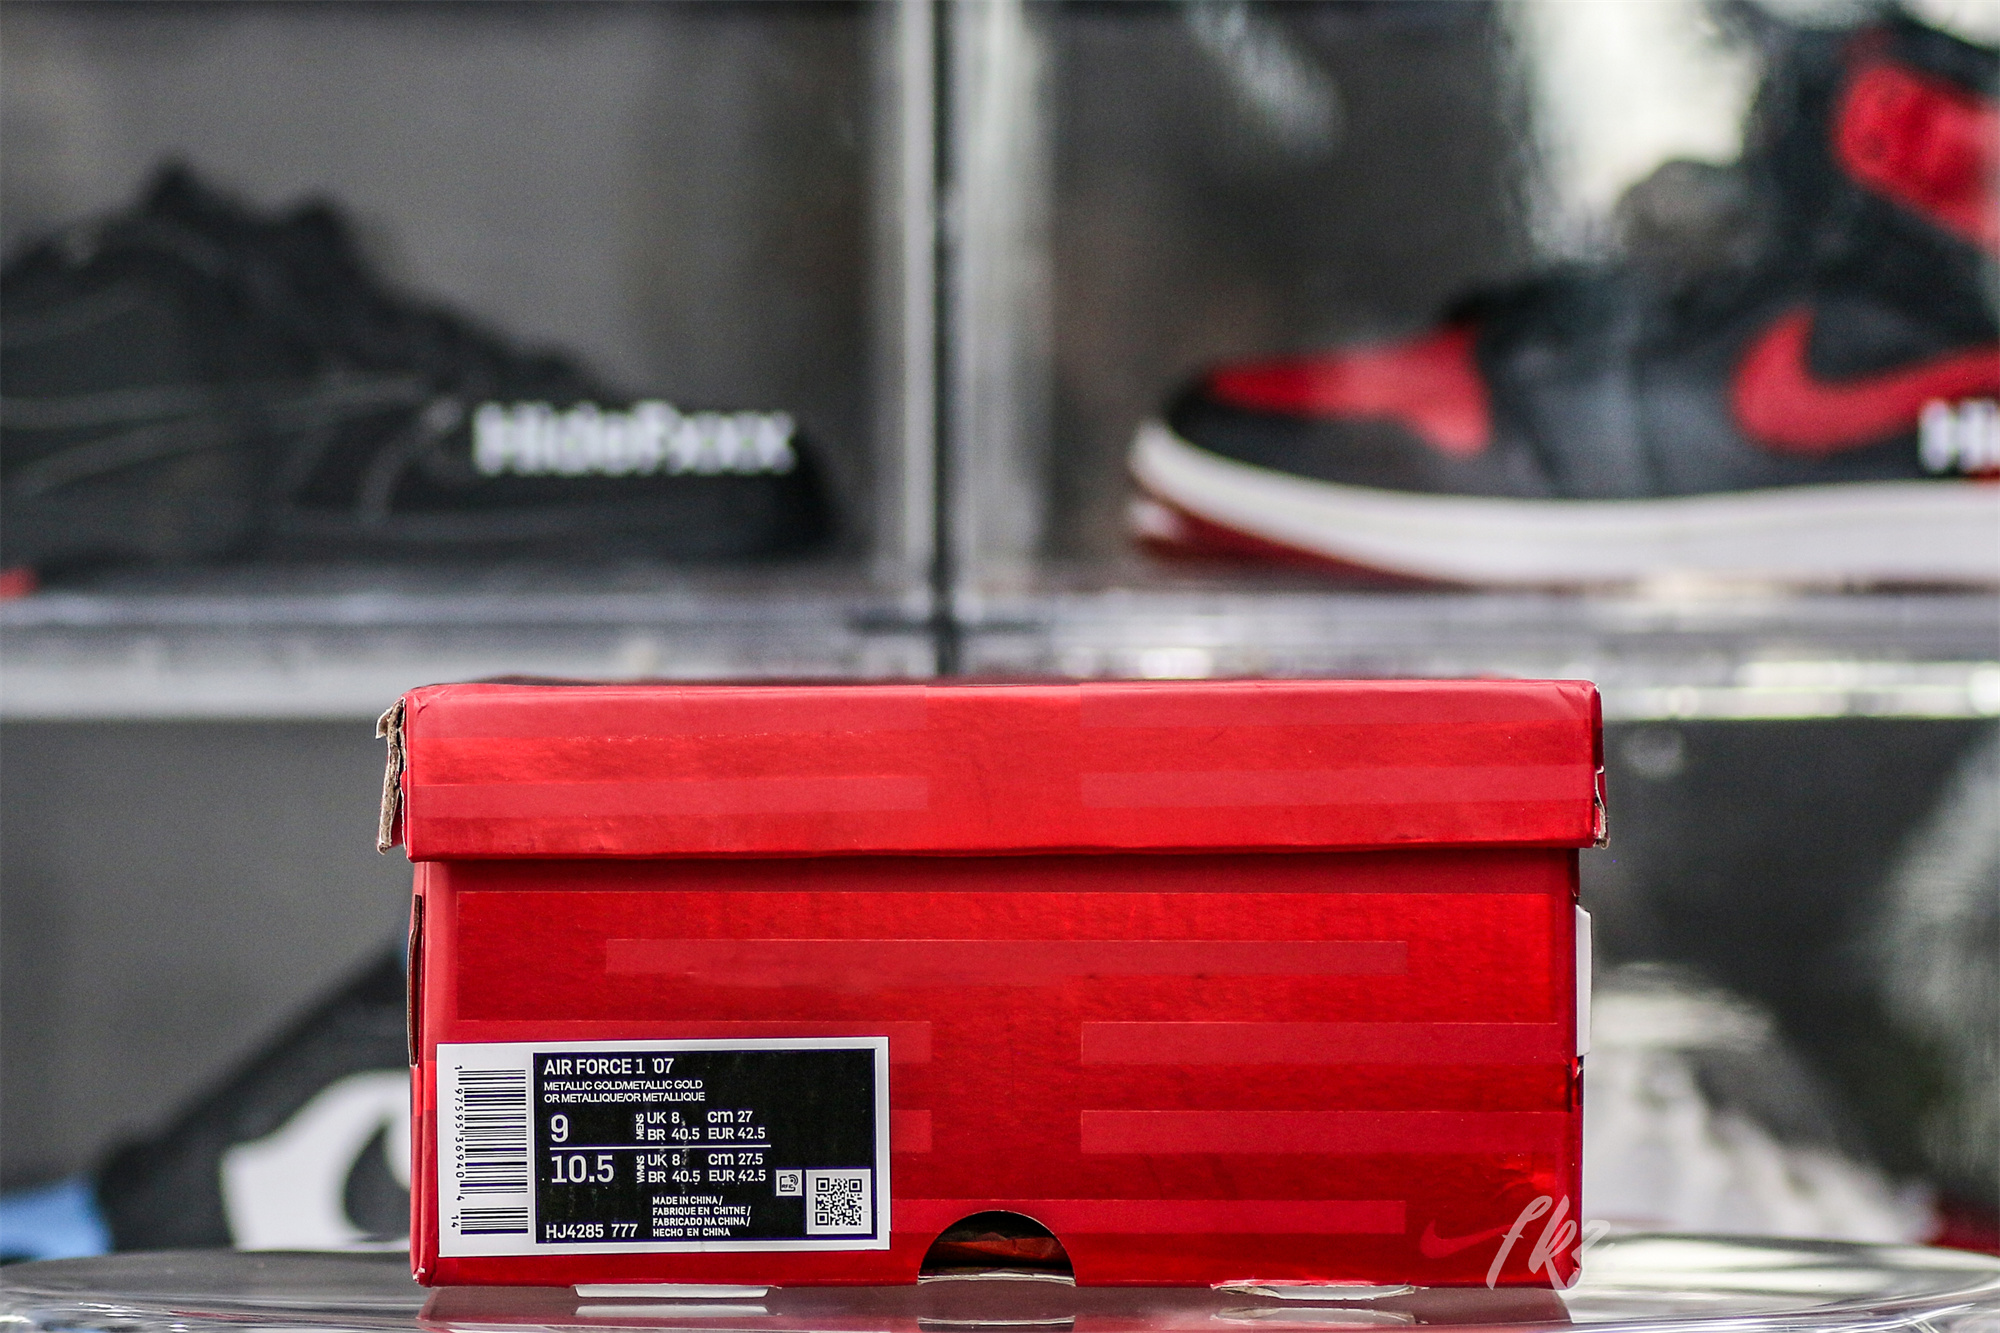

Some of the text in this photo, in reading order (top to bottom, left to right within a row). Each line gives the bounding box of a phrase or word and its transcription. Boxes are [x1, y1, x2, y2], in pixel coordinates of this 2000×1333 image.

[543, 1057, 675, 1076] AIR FORCE 1 '07
[543, 1079, 704, 1091] METALLIC GOLD/METALLIC GOLD
[544, 1092, 706, 1104] OR METALLIQUE/OR METALLIQUE
[646, 1110, 753, 1124] UK 8 cm 27
[550, 1114, 569, 1143] 9
[635, 1113, 645, 1140] MENS
[647, 1127, 766, 1141] BR 40.5 EUR 42.5
[647, 1153, 764, 1167] UK 8 cm 27.5
[550, 1154, 615, 1184] 10.5
[636, 1155, 646, 1184] WMNS
[648, 1169, 767, 1183] BR 40.5 EUR 42.5
[652, 1196, 678, 1205] MADE
[679, 1196, 689, 1205] IN
[652, 1206, 696, 1216] FABRIQUE
[697, 1206, 710, 1215] EN
[652, 1217, 703, 1227] FABRICADO
[703, 1217, 717, 1226] NA
[545, 1223, 639, 1239] HJ4285 777
[652, 1227, 731, 1237] HECHO EN CHINA
